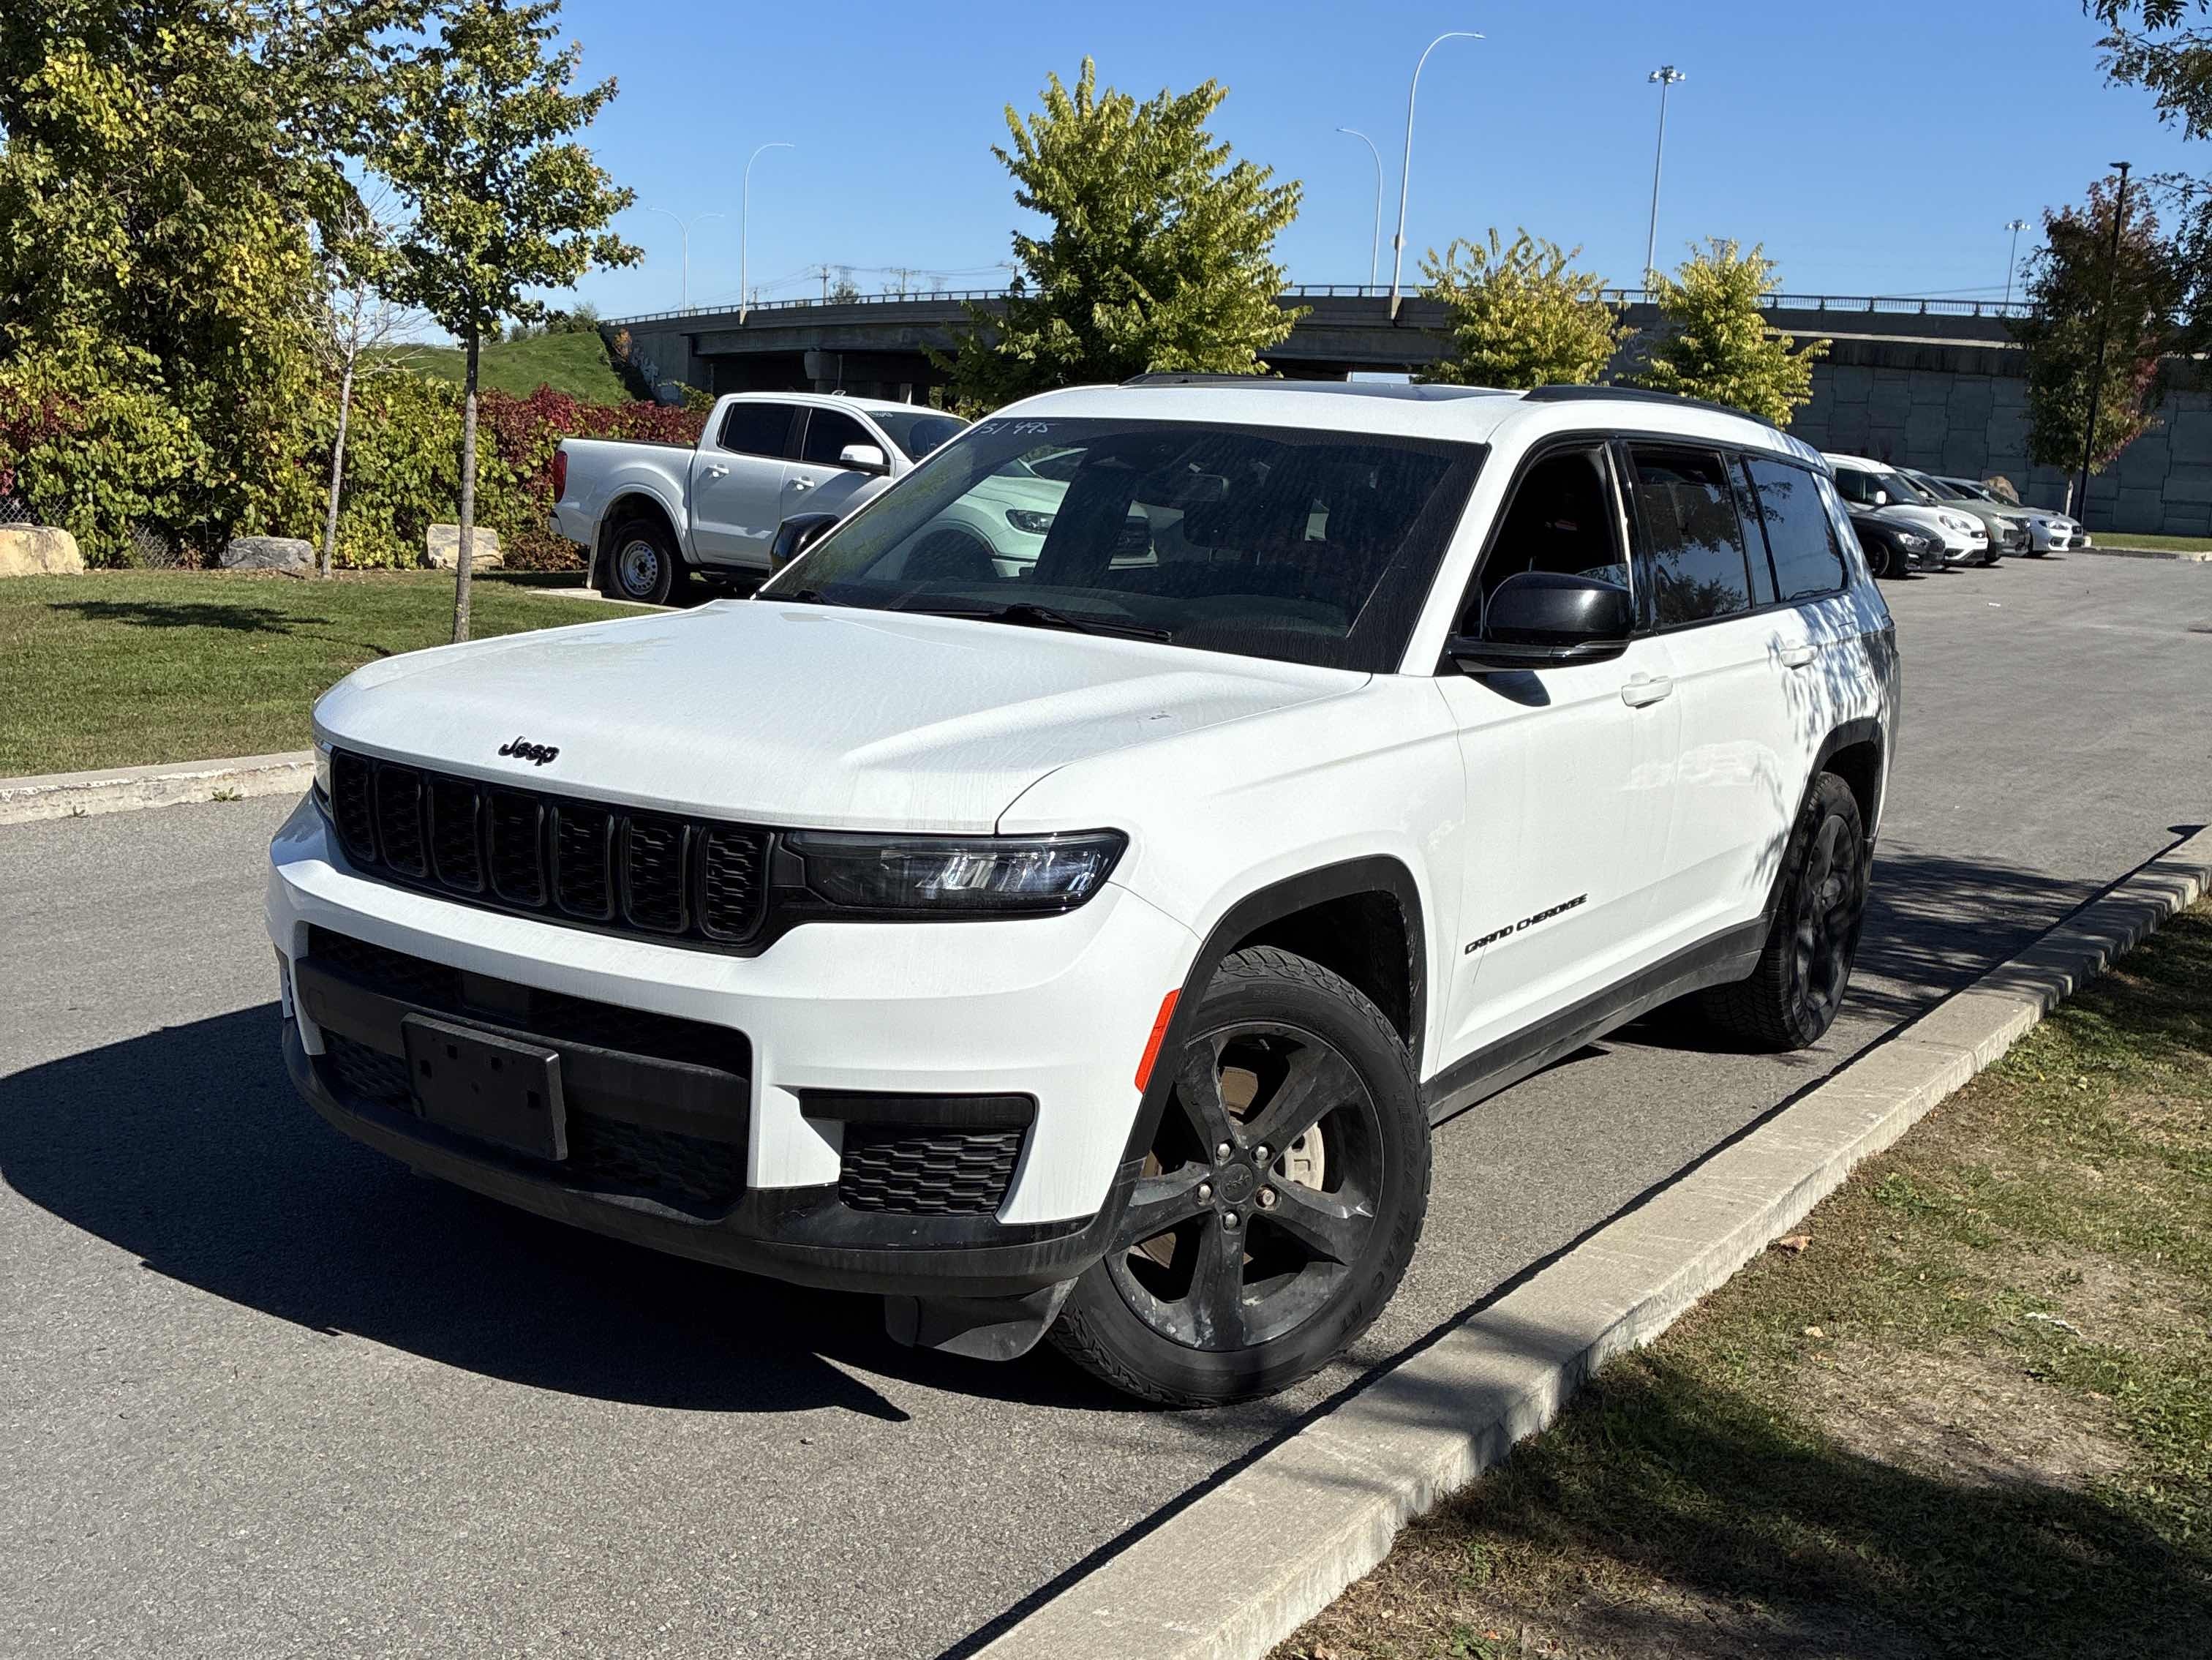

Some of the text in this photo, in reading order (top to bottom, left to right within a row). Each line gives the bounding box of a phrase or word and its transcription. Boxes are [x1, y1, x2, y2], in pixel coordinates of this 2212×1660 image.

[498, 735, 560, 766] Jeep
[1464, 893, 1588, 955] GRAND CHEROKEE
